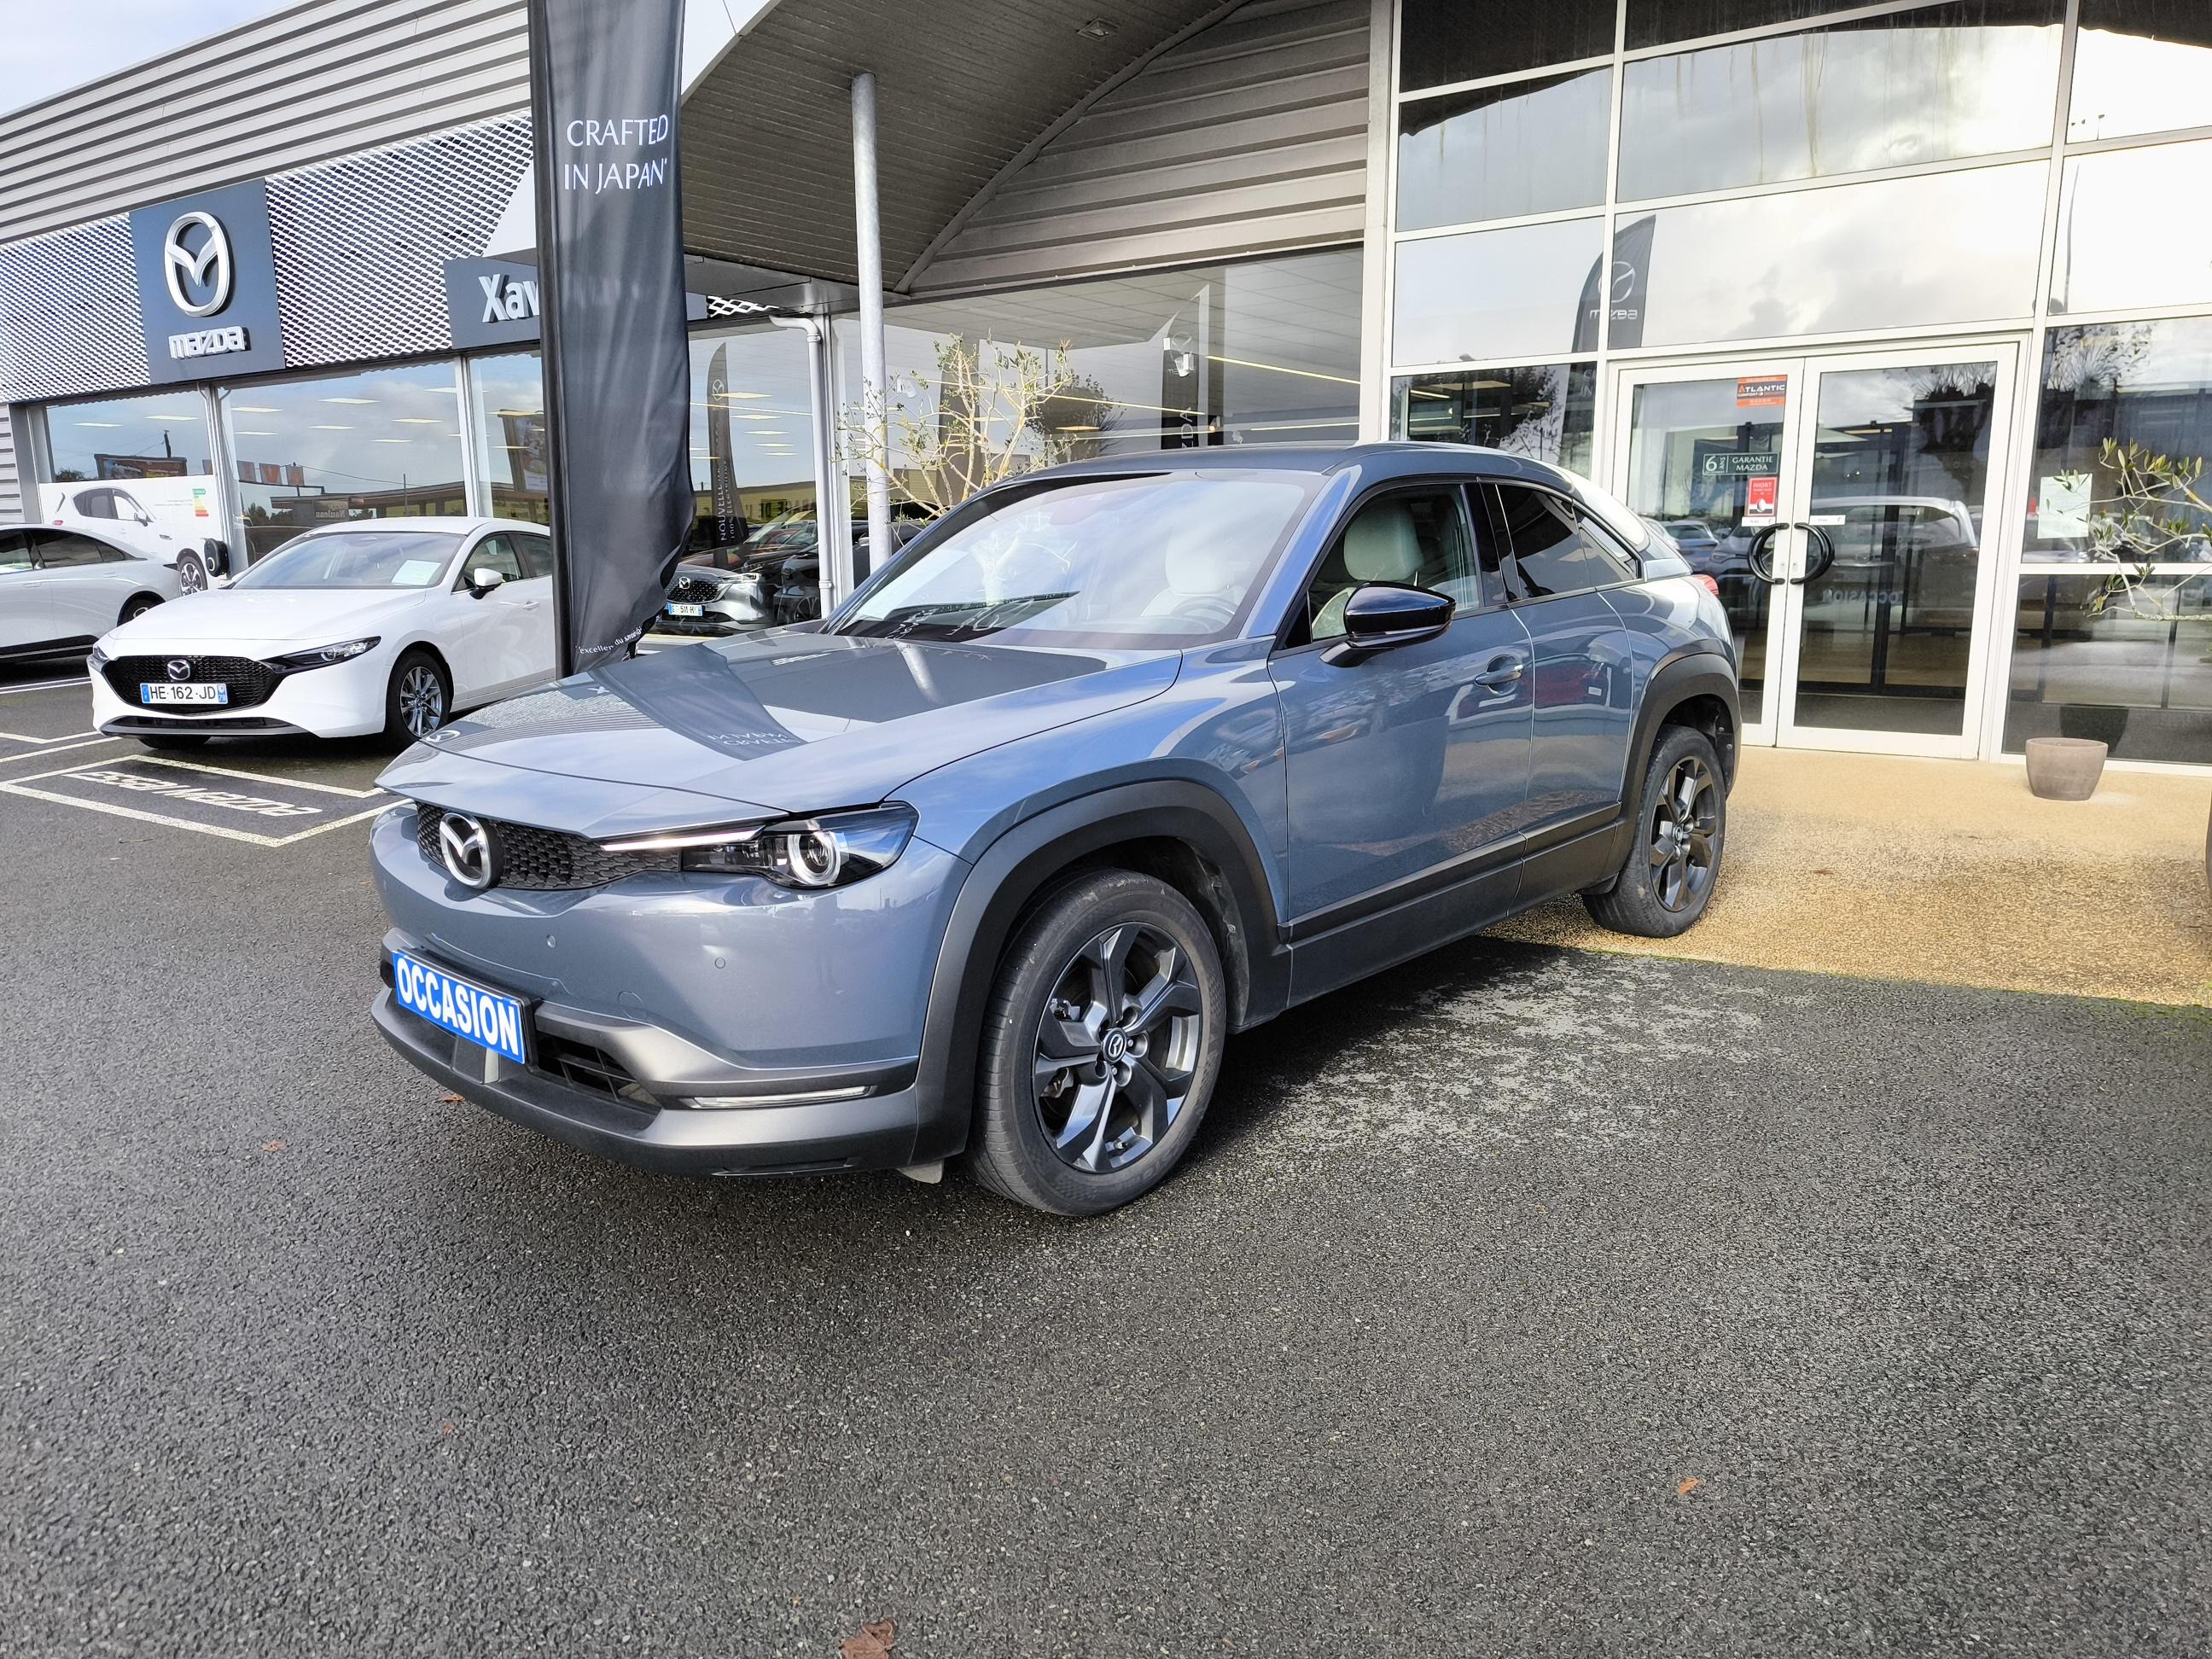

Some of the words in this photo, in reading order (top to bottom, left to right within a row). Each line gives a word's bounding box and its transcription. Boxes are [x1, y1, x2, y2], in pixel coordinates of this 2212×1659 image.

[567, 114, 669, 147] CRAFTED
[564, 163, 589, 189] IN
[1738, 384, 1785, 393] ATLANTIC
[1706, 455, 1718, 472] 6
[397, 958, 519, 1056] OCCASION
